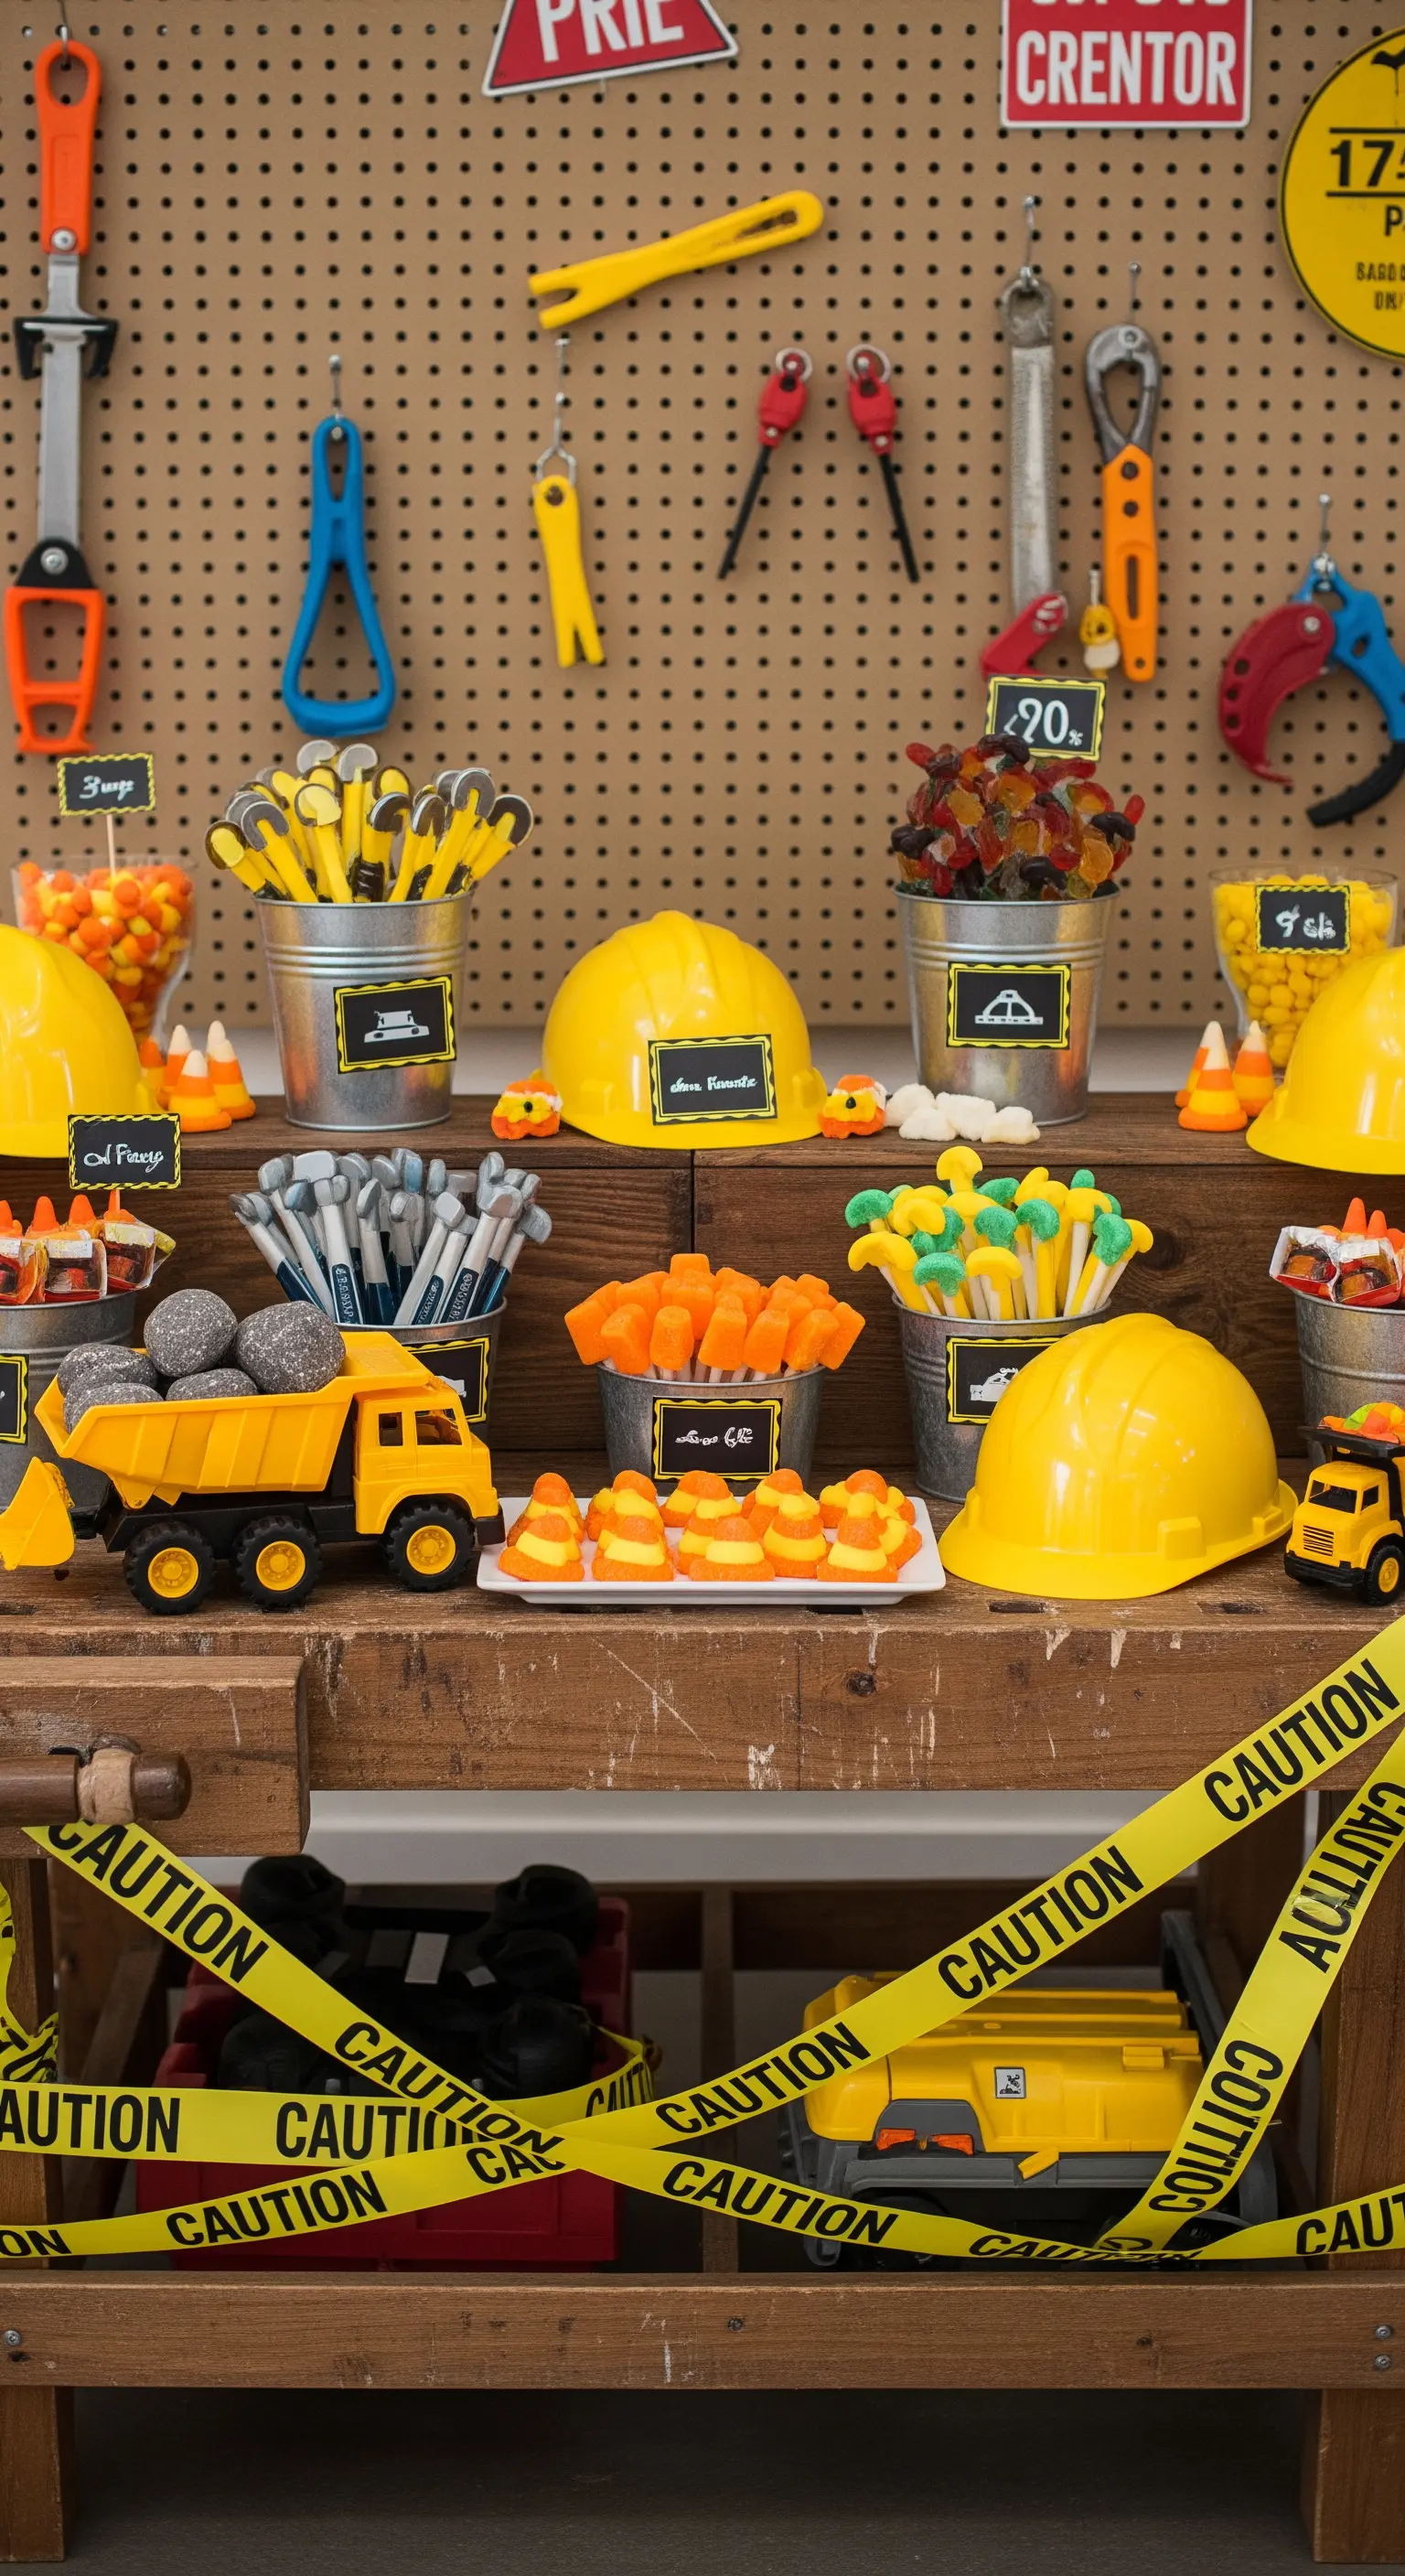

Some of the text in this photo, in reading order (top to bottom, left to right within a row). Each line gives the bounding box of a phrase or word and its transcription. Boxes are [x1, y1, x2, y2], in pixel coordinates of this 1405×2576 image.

[1015, 29, 1238, 106] CRENTOR
[48, 1819, 270, 1984] CAUTION
[334, 2022, 566, 2154] CAUTION
[662, 2161, 899, 2244] CAUTION
[166, 2169, 388, 2247] CAUTION
[655, 2022, 872, 2134] CAUTION
[937, 1844, 1144, 1999] CAUTION
[1204, 1658, 1400, 1821] CAUTION
[0, 2088, 181, 2153] AUTION
[276, 2101, 497, 2160] CAUTIO
